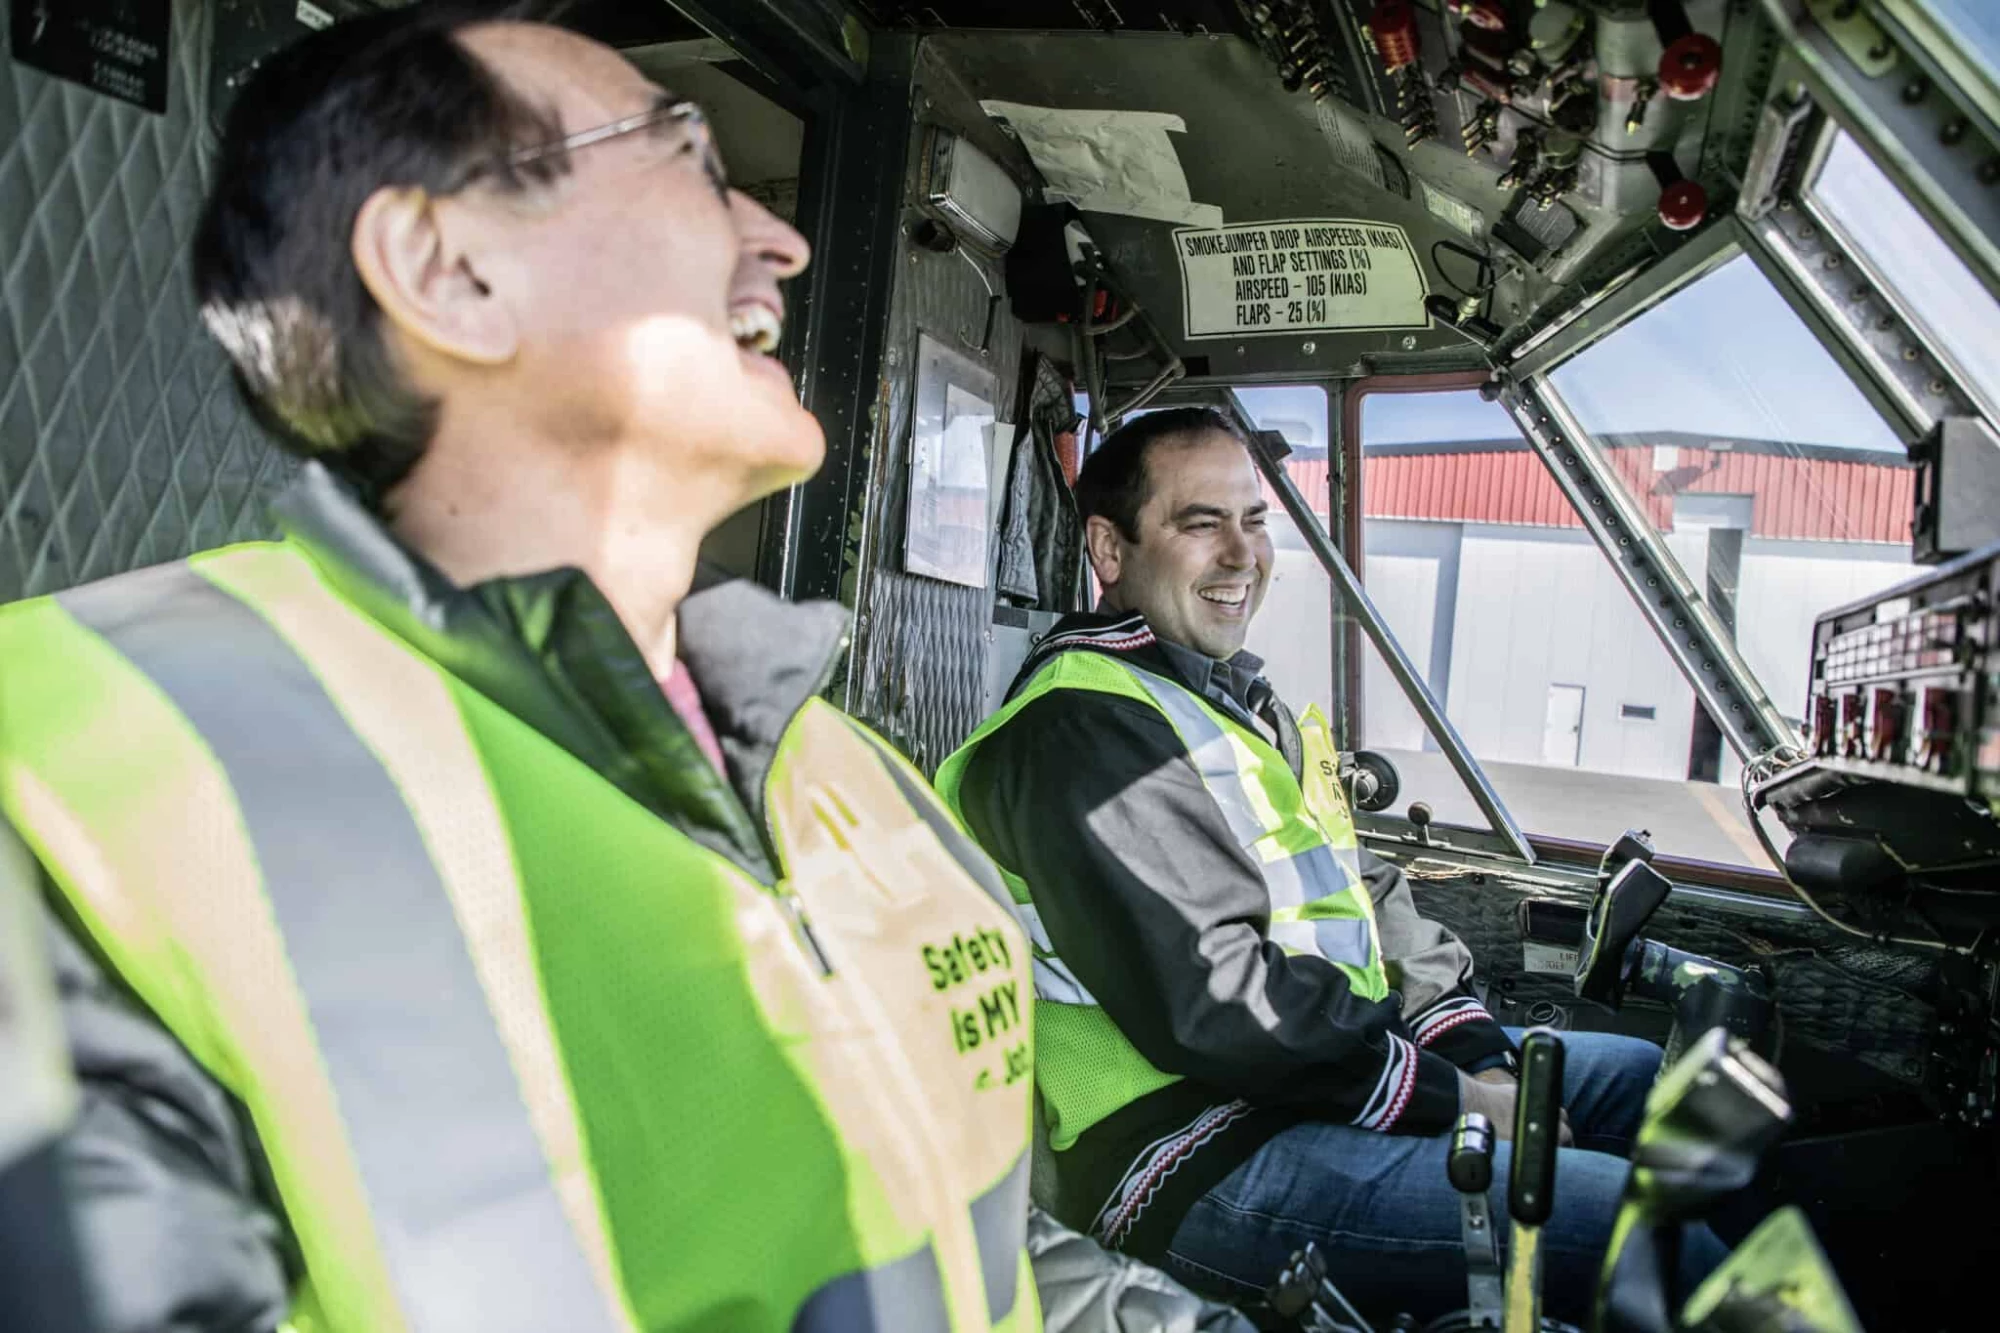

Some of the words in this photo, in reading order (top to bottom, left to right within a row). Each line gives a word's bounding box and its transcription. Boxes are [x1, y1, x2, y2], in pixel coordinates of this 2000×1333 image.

[1185, 232, 1268, 257] SMOKEJUMPER
[1273, 230, 1300, 248] DROP
[1305, 228, 1366, 247] AIRSPEEDS
[1366, 228, 1403, 250] (KIAS)
[1233, 255, 1255, 277] AND
[1260, 254, 1286, 274] FLAP
[1290, 251, 1347, 273] SETTINGS
[1350, 249, 1372, 271] (%)
[1235, 279, 1289, 301] AIRSPEED
[1306, 277, 1326, 297] 105
[1330, 272, 1367, 297] (KIAS)
[1236, 303, 1271, 326] FLAPS
[1288, 303, 1303, 324] 25
[1306, 301, 1326, 323] (%)
[921, 924, 1012, 990] Safety
